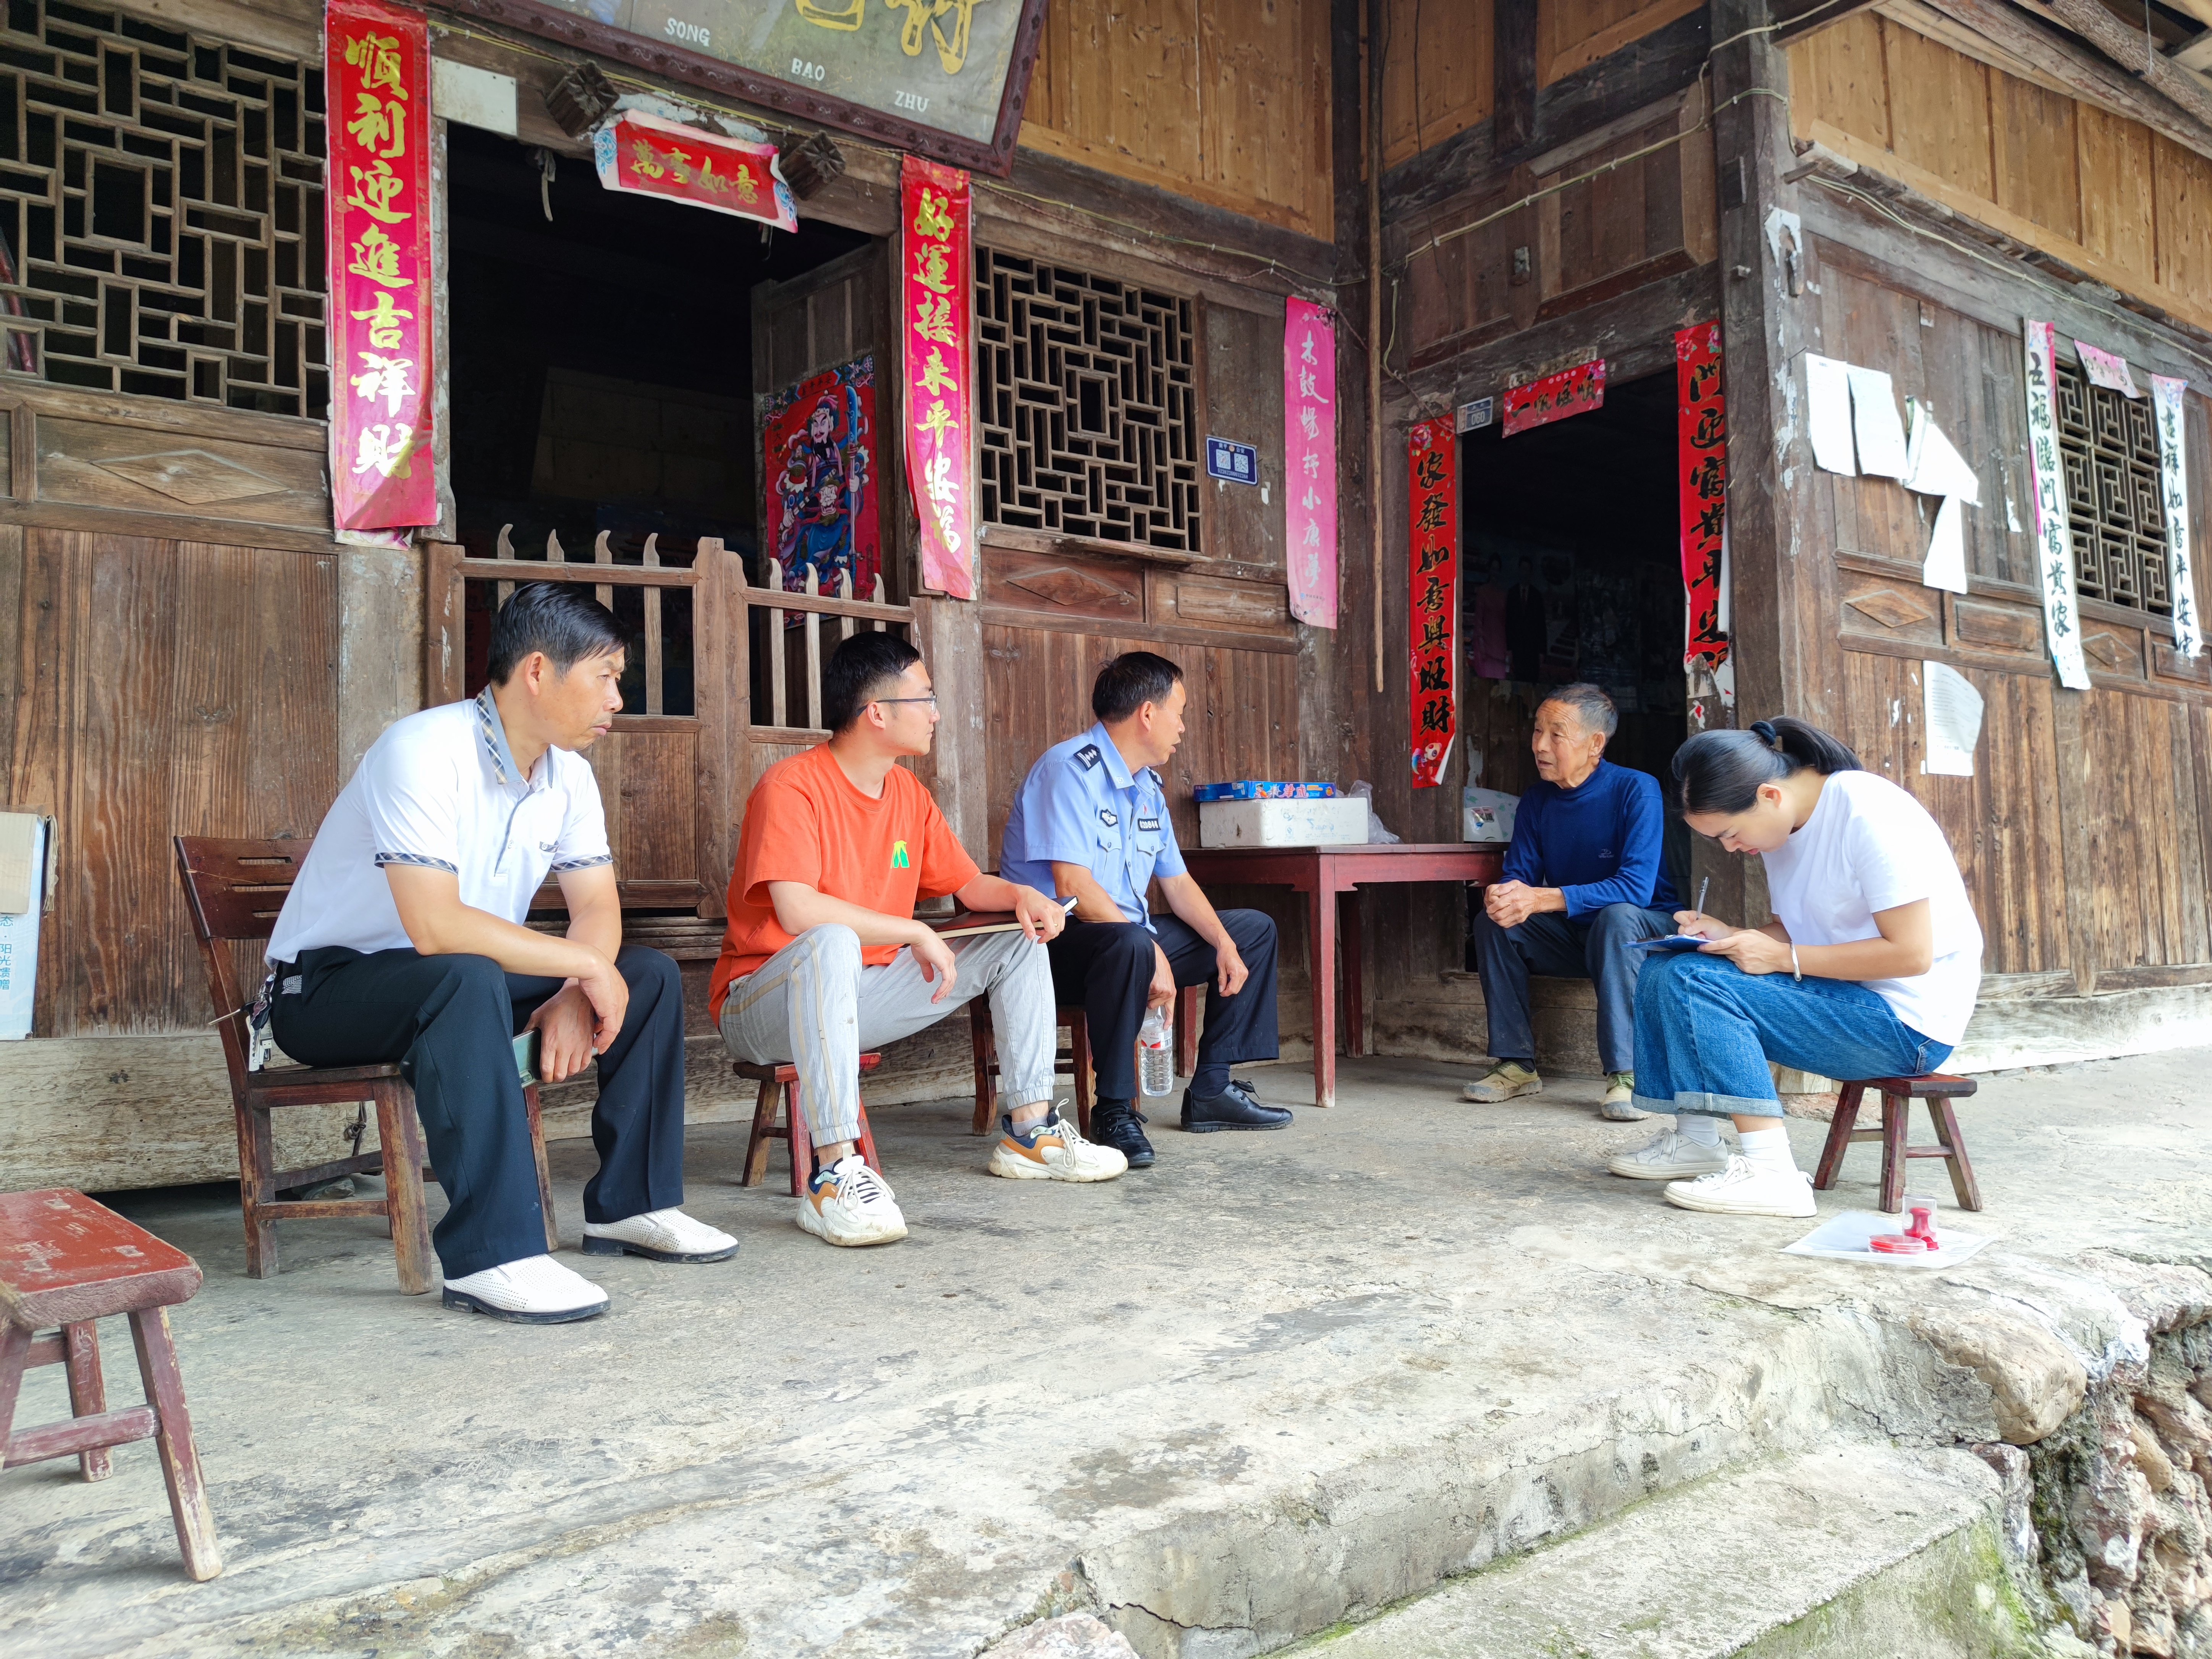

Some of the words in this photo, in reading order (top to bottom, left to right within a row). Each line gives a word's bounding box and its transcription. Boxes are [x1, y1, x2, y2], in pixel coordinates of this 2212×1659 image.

[664, 17, 711, 47] SONG
[791, 57, 825, 81] BAO
[894, 90, 930, 112] ZHU
[1471, 411, 1485, 425] 060
